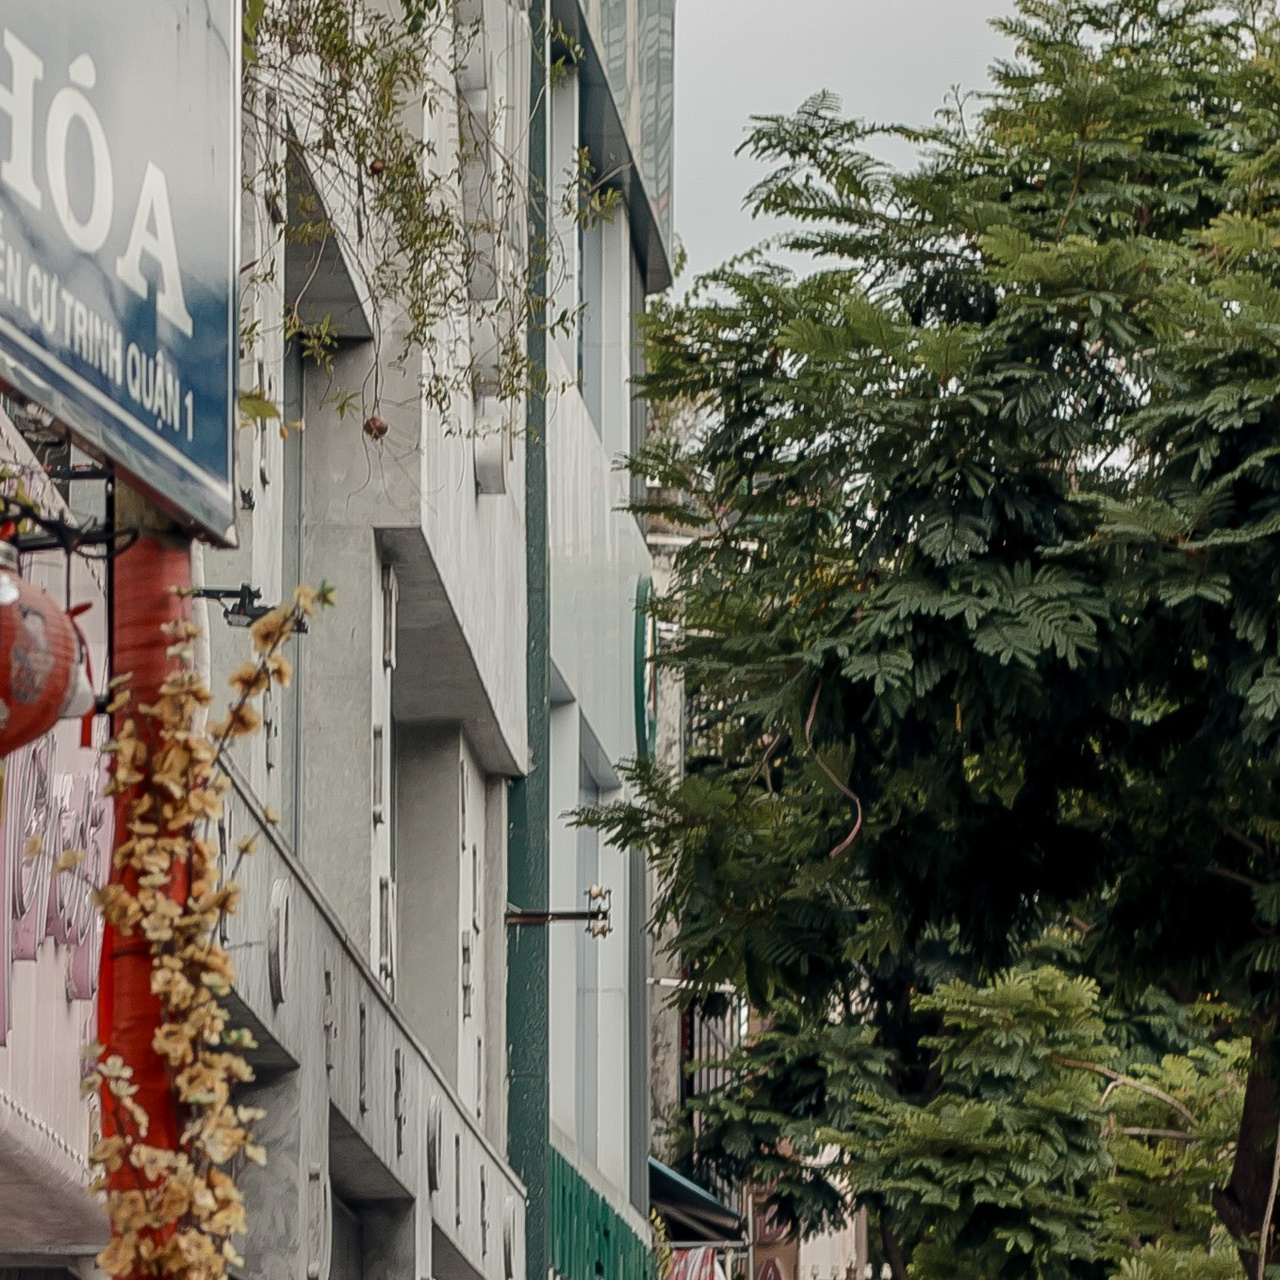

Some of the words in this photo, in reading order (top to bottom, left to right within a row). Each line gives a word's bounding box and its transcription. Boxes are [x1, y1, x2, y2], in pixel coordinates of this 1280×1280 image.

[26, 262, 59, 335] CƯ
[60, 290, 122, 387] TRINH
[126, 341, 181, 432] QUẬN
[184, 391, 195, 443] 1
